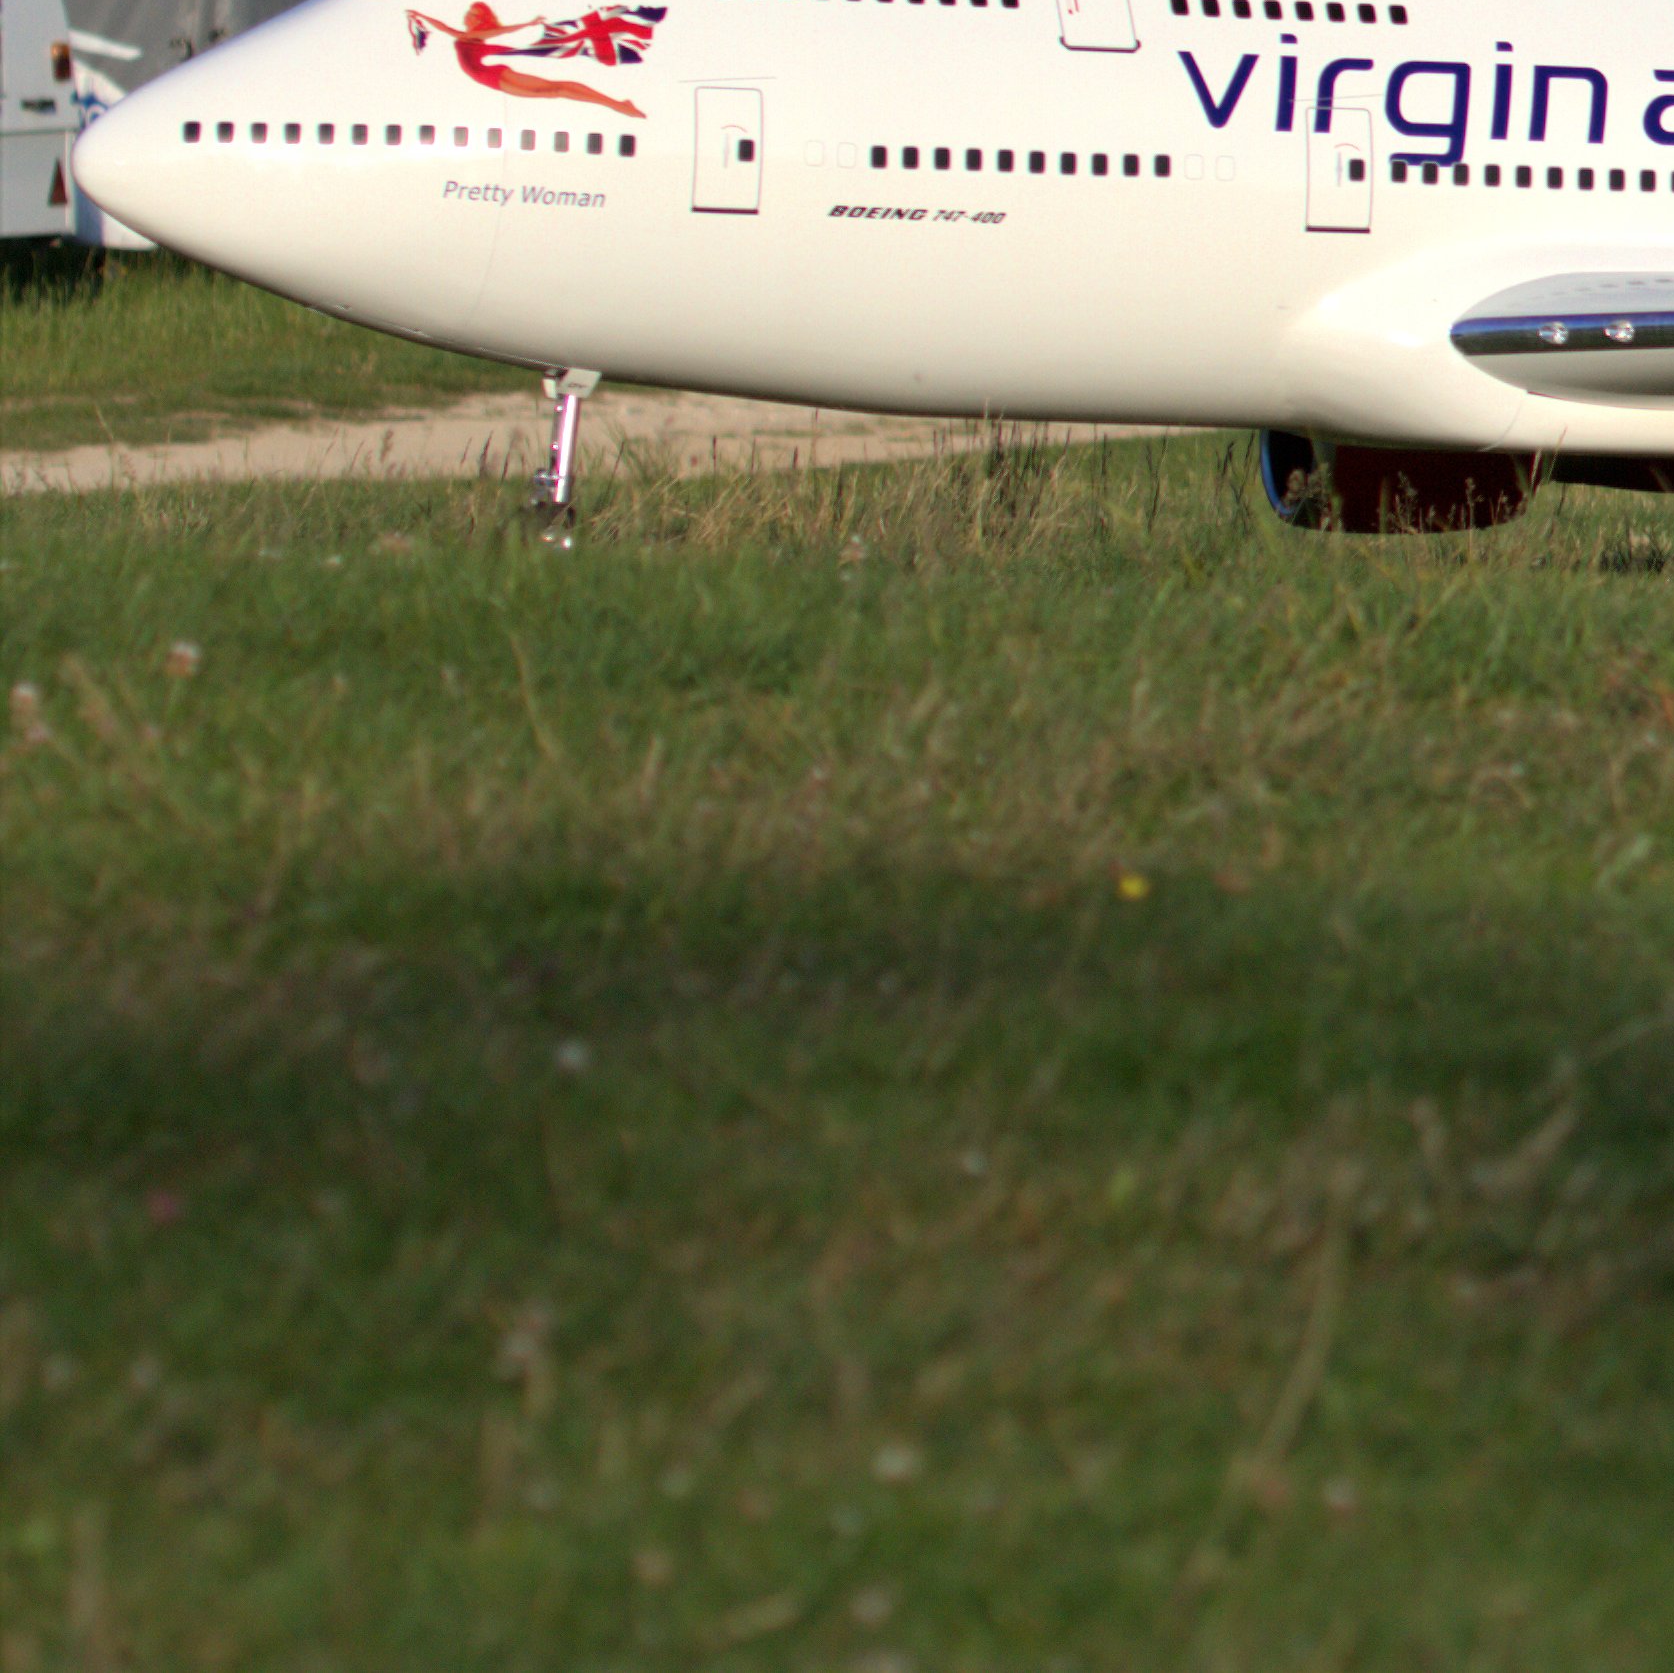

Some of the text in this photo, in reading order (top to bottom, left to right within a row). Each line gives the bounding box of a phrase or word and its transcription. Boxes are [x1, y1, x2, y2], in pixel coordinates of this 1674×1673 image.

[1177, 33, 1609, 167] virgin
[443, 180, 607, 208] Pretty Woman
[828, 204, 1008, 224] BOEING 747-400
